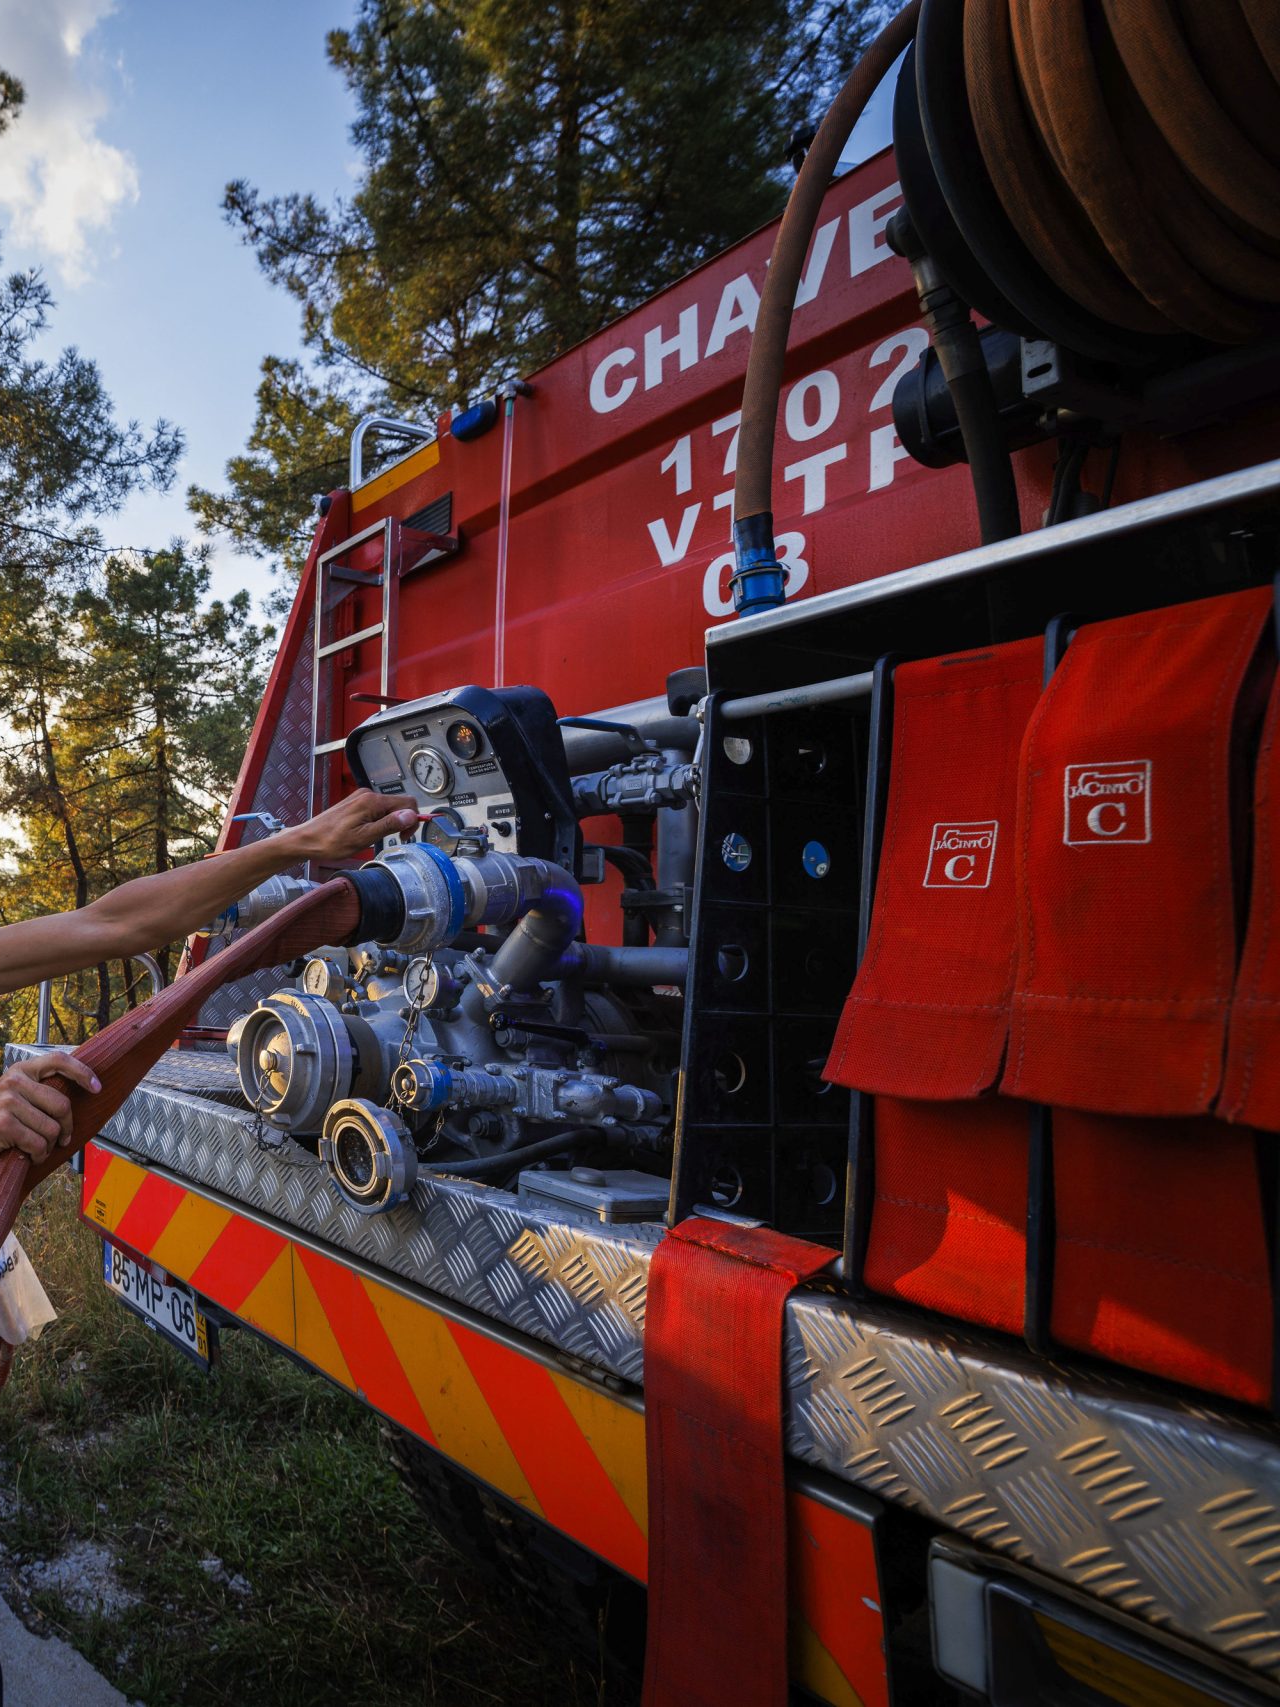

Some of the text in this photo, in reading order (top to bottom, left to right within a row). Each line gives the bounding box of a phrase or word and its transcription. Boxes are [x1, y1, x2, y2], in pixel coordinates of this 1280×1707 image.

[1068, 778, 1144, 799] JACINTO
[1087, 802, 1127, 836] C
[933, 836, 992, 851] JACINTO
[944, 854, 976, 882] C
